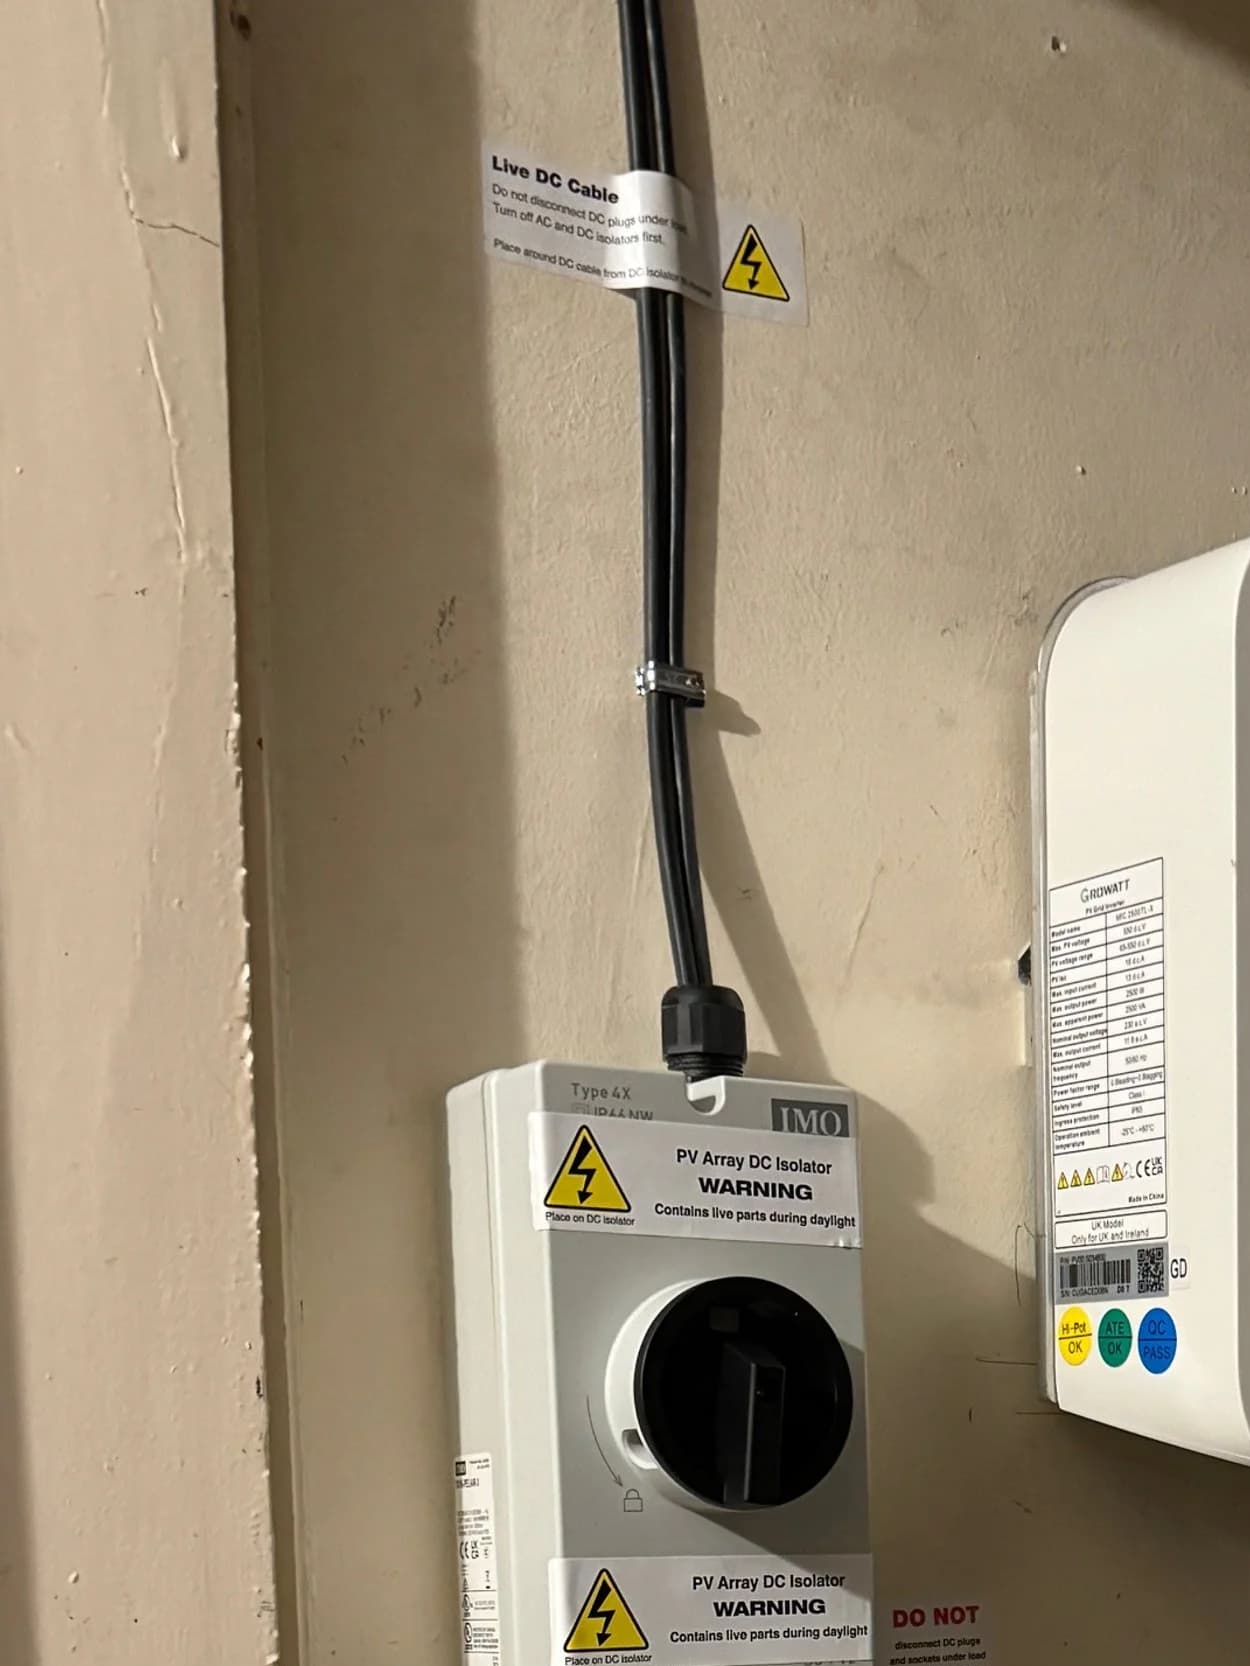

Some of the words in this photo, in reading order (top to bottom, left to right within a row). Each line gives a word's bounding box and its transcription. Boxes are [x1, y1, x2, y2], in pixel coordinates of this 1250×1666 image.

[492, 155, 530, 180] Live
[535, 167, 562, 189] DC
[567, 178, 619, 205] Cable
[492, 183, 509, 198] Do
[511, 188, 528, 203] not
[530, 195, 587, 220] disconnect
[588, 210, 606, 225] DC
[608, 217, 636, 229] plugs
[493, 201, 517, 219] Turn
[519, 209, 534, 223] off
[535, 214, 553, 228] AC
[555, 220, 574, 236] and
[577, 226, 595, 240] DC
[596, 231, 639, 246] isolators
[493, 237, 521, 255] Place
[558, 255, 574, 271] DC
[1080, 879, 1131, 904] GROWATT
[570, 1082, 608, 1100] Type
[611, 1084, 631, 1100] 4X
[779, 1106, 842, 1137] IMO
[676, 1148, 698, 1165] PV
[702, 1150, 745, 1171] Array
[748, 1154, 772, 1170] DC
[775, 1156, 833, 1175] Isolator
[698, 1176, 814, 1201] WARNING
[1149, 1192, 1164, 1201] China
[545, 1211, 572, 1223] Place
[572, 1213, 585, 1224] on
[586, 1213, 601, 1224] DC
[602, 1214, 635, 1226] isolator
[654, 1202, 710, 1221] Contains
[711, 1205, 734, 1221] live
[736, 1208, 767, 1224] parts
[769, 1209, 808, 1228] during
[810, 1211, 857, 1229] daylight
[1091, 1220, 1102, 1231] UK
[1103, 1218, 1124, 1230] Model
[1071, 1234, 1086, 1246] Only
[1088, 1233, 1097, 1243] for
[1098, 1231, 1108, 1242] UK
[1111, 1229, 1123, 1240] and
[1125, 1227, 1149, 1239] Ireland
[1170, 1257, 1187, 1279] GD
[1061, 1321, 1086, 1335] Hi-Pot
[1105, 1321, 1125, 1335] ATE
[1147, 1319, 1167, 1336] QC
[1068, 1340, 1083, 1355] OK
[1107, 1341, 1122, 1355] OK
[1143, 1345, 1171, 1361] PASS
[692, 1575, 714, 1591] PV
[716, 1575, 759, 1592] Array
[763, 1574, 786, 1589] DC
[789, 1573, 846, 1588] Isolator
[713, 1599, 827, 1618] WARNING
[892, 1608, 926, 1629] DO
[933, 1605, 980, 1626] NOT
[670, 1630, 724, 1644] Contains
[725, 1629, 748, 1642] live
[750, 1628, 780, 1644] parts
[782, 1626, 821, 1642] during
[822, 1624, 868, 1640] daylight
[894, 1639, 941, 1650] disconnect
[943, 1638, 956, 1647] DC
[957, 1637, 981, 1648] plugs
[564, 1656, 590, 1666] Place
[591, 1656, 604, 1665] on
[605, 1655, 620, 1665] DC
[621, 1653, 652, 1664] isolator
[889, 1655, 906, 1666] and
[908, 1654, 941, 1664] sockets
[942, 1652, 967, 1662] under
[968, 1650, 987, 1660] load
